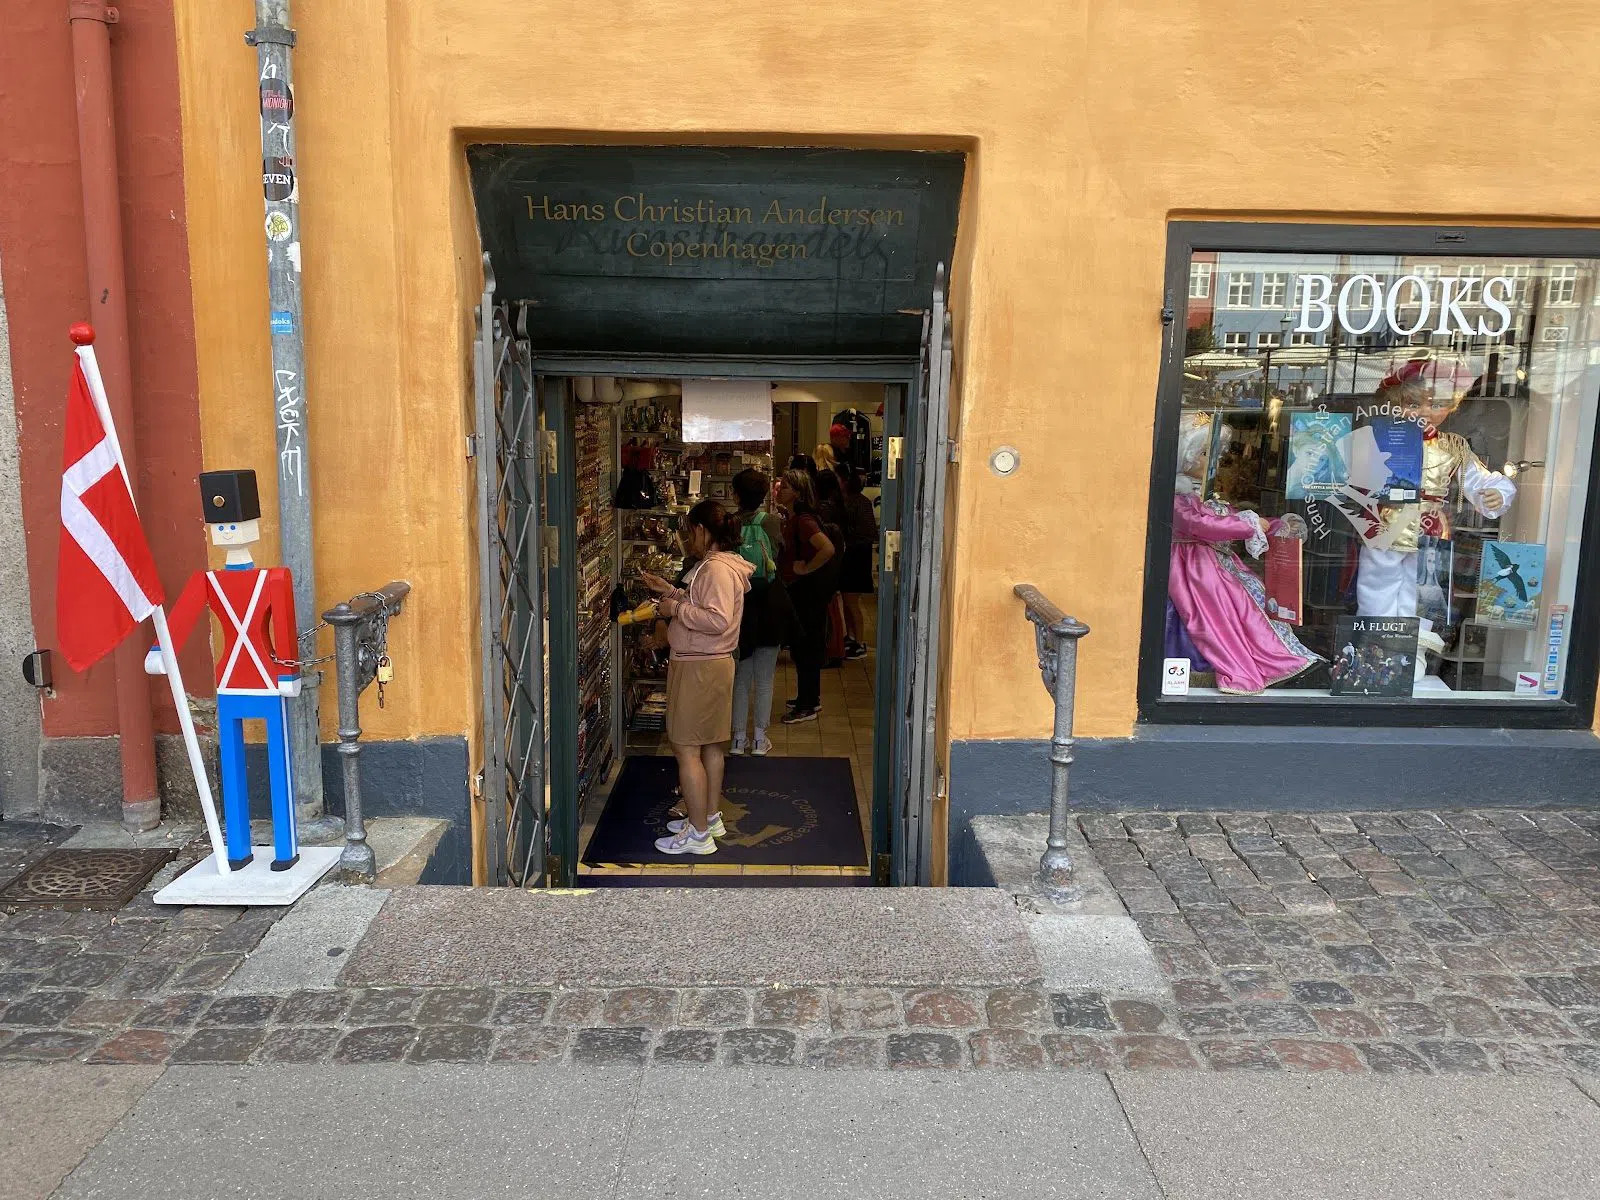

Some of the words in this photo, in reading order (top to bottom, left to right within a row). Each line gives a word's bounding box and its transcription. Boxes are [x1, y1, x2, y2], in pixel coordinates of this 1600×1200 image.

[523, 195, 605, 223] Hans
[613, 192, 752, 225] Christian
[761, 196, 904, 227] Andersen
[626, 230, 809, 268] Copenhagen
[1293, 273, 1514, 337] BOOKS
[1303, 493, 1331, 541] Hans
[1355, 401, 1437, 437] Andersen
[1353, 619, 1366, 631] PÅ
[1369, 621, 1407, 632] FLUGT
